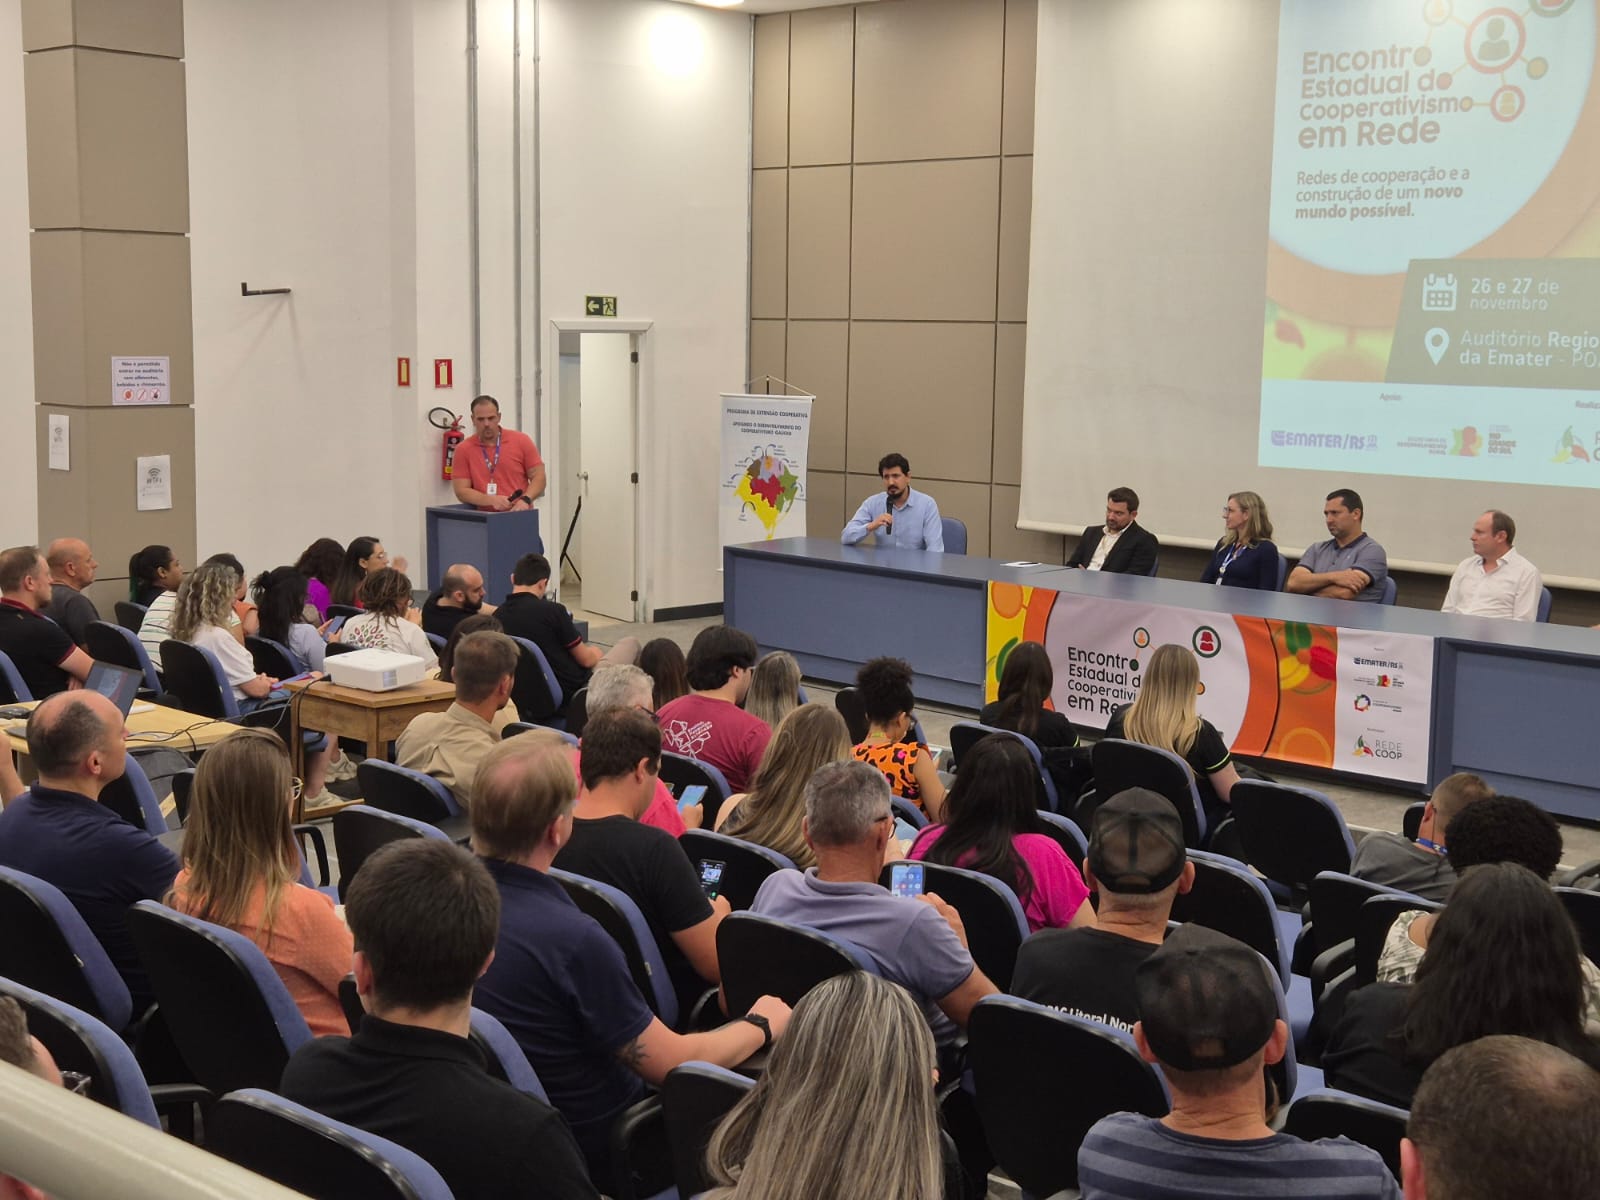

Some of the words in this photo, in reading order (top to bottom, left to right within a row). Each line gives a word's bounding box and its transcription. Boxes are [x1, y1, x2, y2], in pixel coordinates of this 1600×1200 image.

[1301, 70, 1410, 99] Estadual
[1298, 125, 1347, 149] em
[1357, 116, 1441, 146] Rede
[1296, 170, 1337, 185] Redes
[1340, 169, 1359, 184] de
[1361, 166, 1446, 186] cooperação
[1449, 169, 1459, 181] e
[1461, 169, 1471, 180] a
[1296, 186, 1371, 204] construção
[1375, 186, 1393, 200] de
[1397, 188, 1420, 200] um
[1424, 186, 1464, 199] novo
[1295, 204, 1348, 219] mundo
[1350, 202, 1415, 221] possível.
[1471, 277, 1491, 294] 26
[1496, 282, 1506, 294] e
[1512, 277, 1533, 294] 27
[1538, 278, 1560, 295] de
[1470, 294, 1548, 311] novembro
[1460, 329, 1542, 347] Auditório
[1548, 331, 1600, 352] Regio
[1459, 349, 1481, 365] da
[1487, 348, 1553, 367] Emater
[1572, 351, 1600, 368] PO
[1286, 432, 1365, 450] EMATER/RS
[1361, 658, 1398, 669] EMATER/RS
[1069, 663, 1128, 686] Estadual
[1131, 674, 1141, 688] d
[1067, 679, 1137, 702] Cooperativi
[1067, 694, 1094, 712] em
[1099, 698, 1120, 715] Re
[1375, 739, 1402, 751] REDE
[1375, 749, 1402, 760] COOP
[1109, 1015, 1134, 1035] Nor
